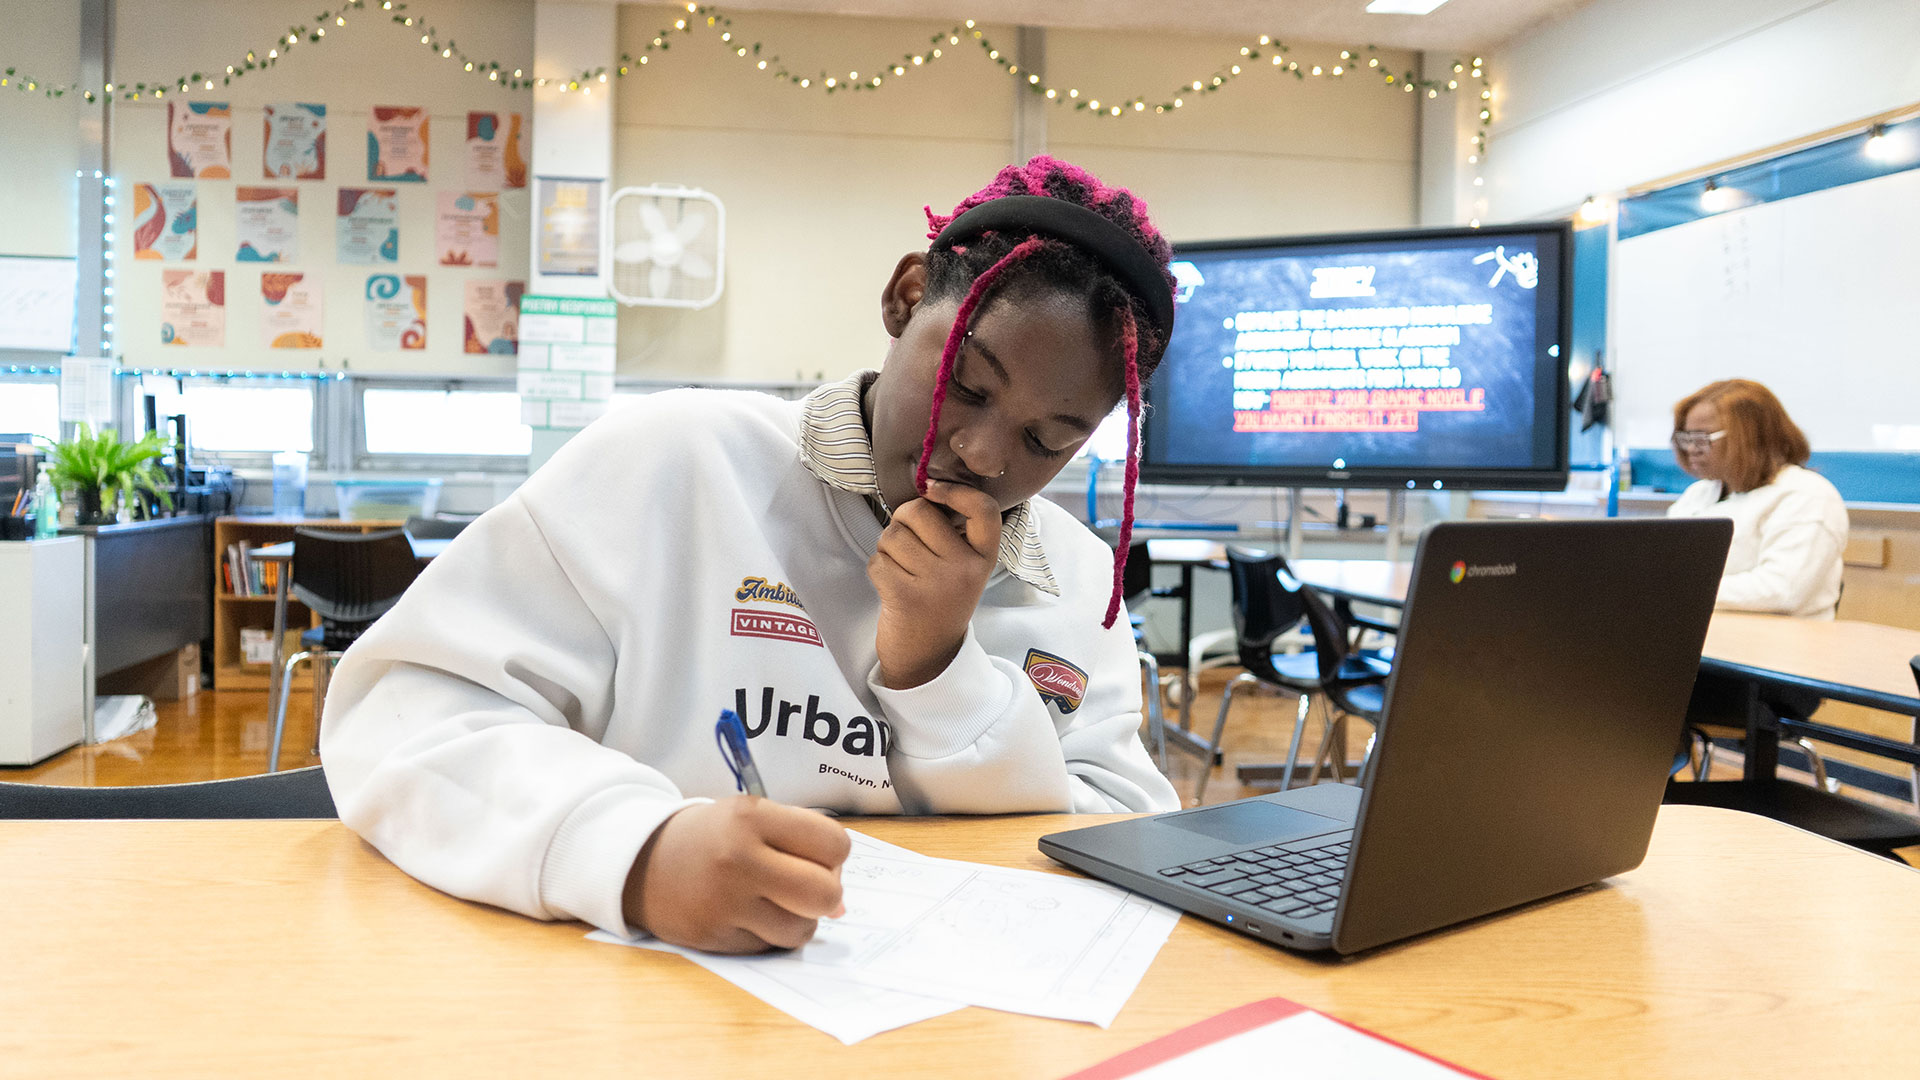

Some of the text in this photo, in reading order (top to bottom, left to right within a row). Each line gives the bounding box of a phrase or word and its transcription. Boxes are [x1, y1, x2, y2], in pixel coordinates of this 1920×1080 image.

[1369, 389, 1424, 408] GRAPHIC
[1424, 389, 1465, 408] NOVEL
[1467, 563, 1517, 577] chromebook
[740, 618, 817, 637] VINTAGE
[819, 763, 893, 788] Brooklyn, N
